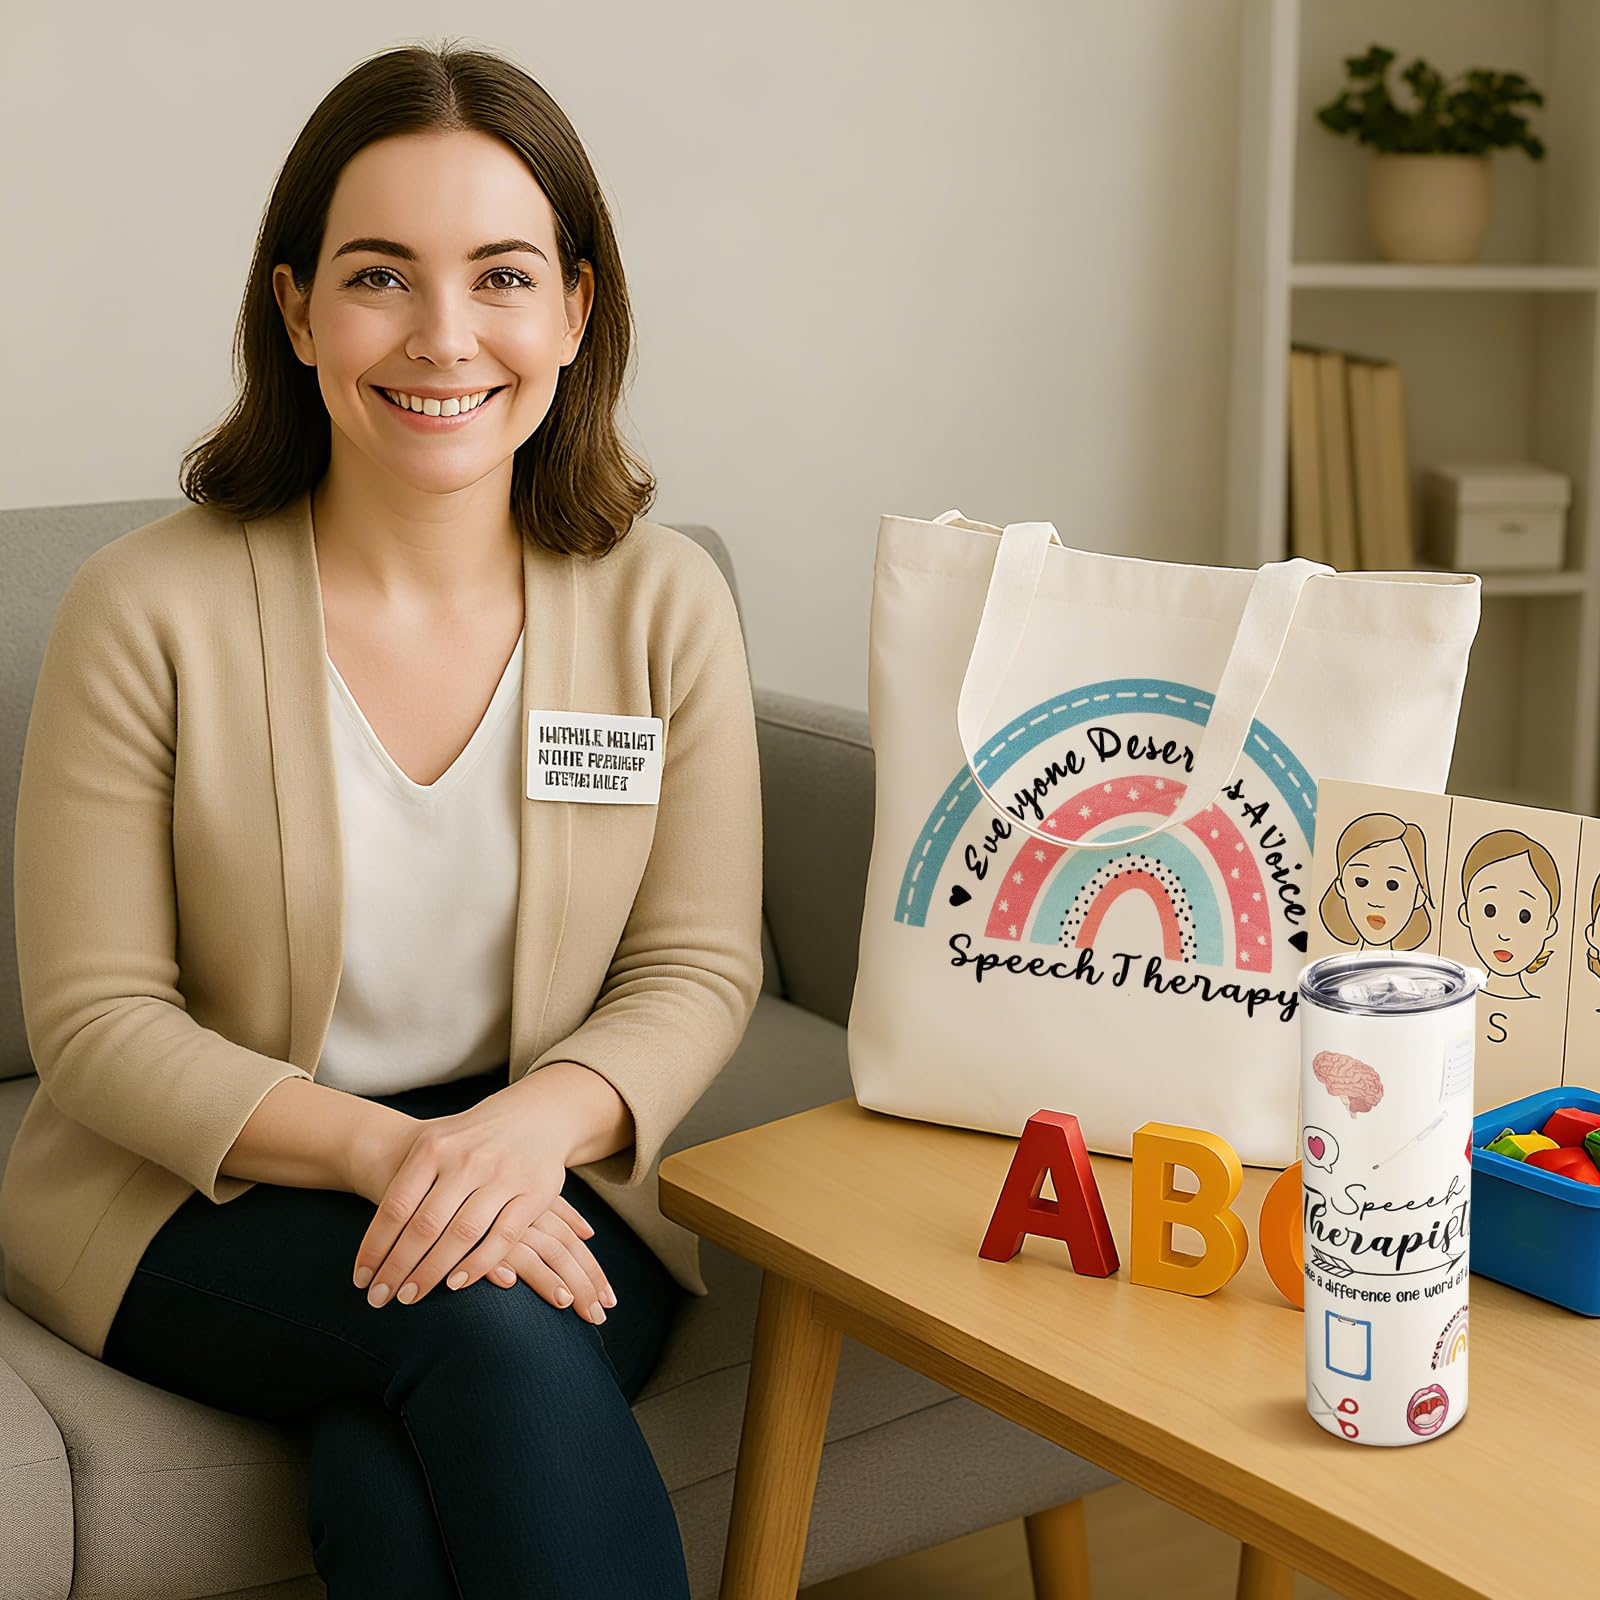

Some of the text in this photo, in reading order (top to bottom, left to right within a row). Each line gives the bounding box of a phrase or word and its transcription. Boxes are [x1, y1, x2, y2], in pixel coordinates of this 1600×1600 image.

[1086, 727, 1245, 800] Desers
[1241, 801, 1270, 828] A
[1260, 824, 1306, 926] Voice
[949, 933, 1300, 1023] Speech Therapy
[1486, 1012, 1508, 1043] S
[1303, 1182, 1469, 1271] Therapist
[1330, 1175, 1466, 1221] Speech
[1317, 1275, 1323, 1288] a
[1325, 1278, 1392, 1303] difference
[1396, 1289, 1420, 1303] one
[1424, 1275, 1453, 1298] word
